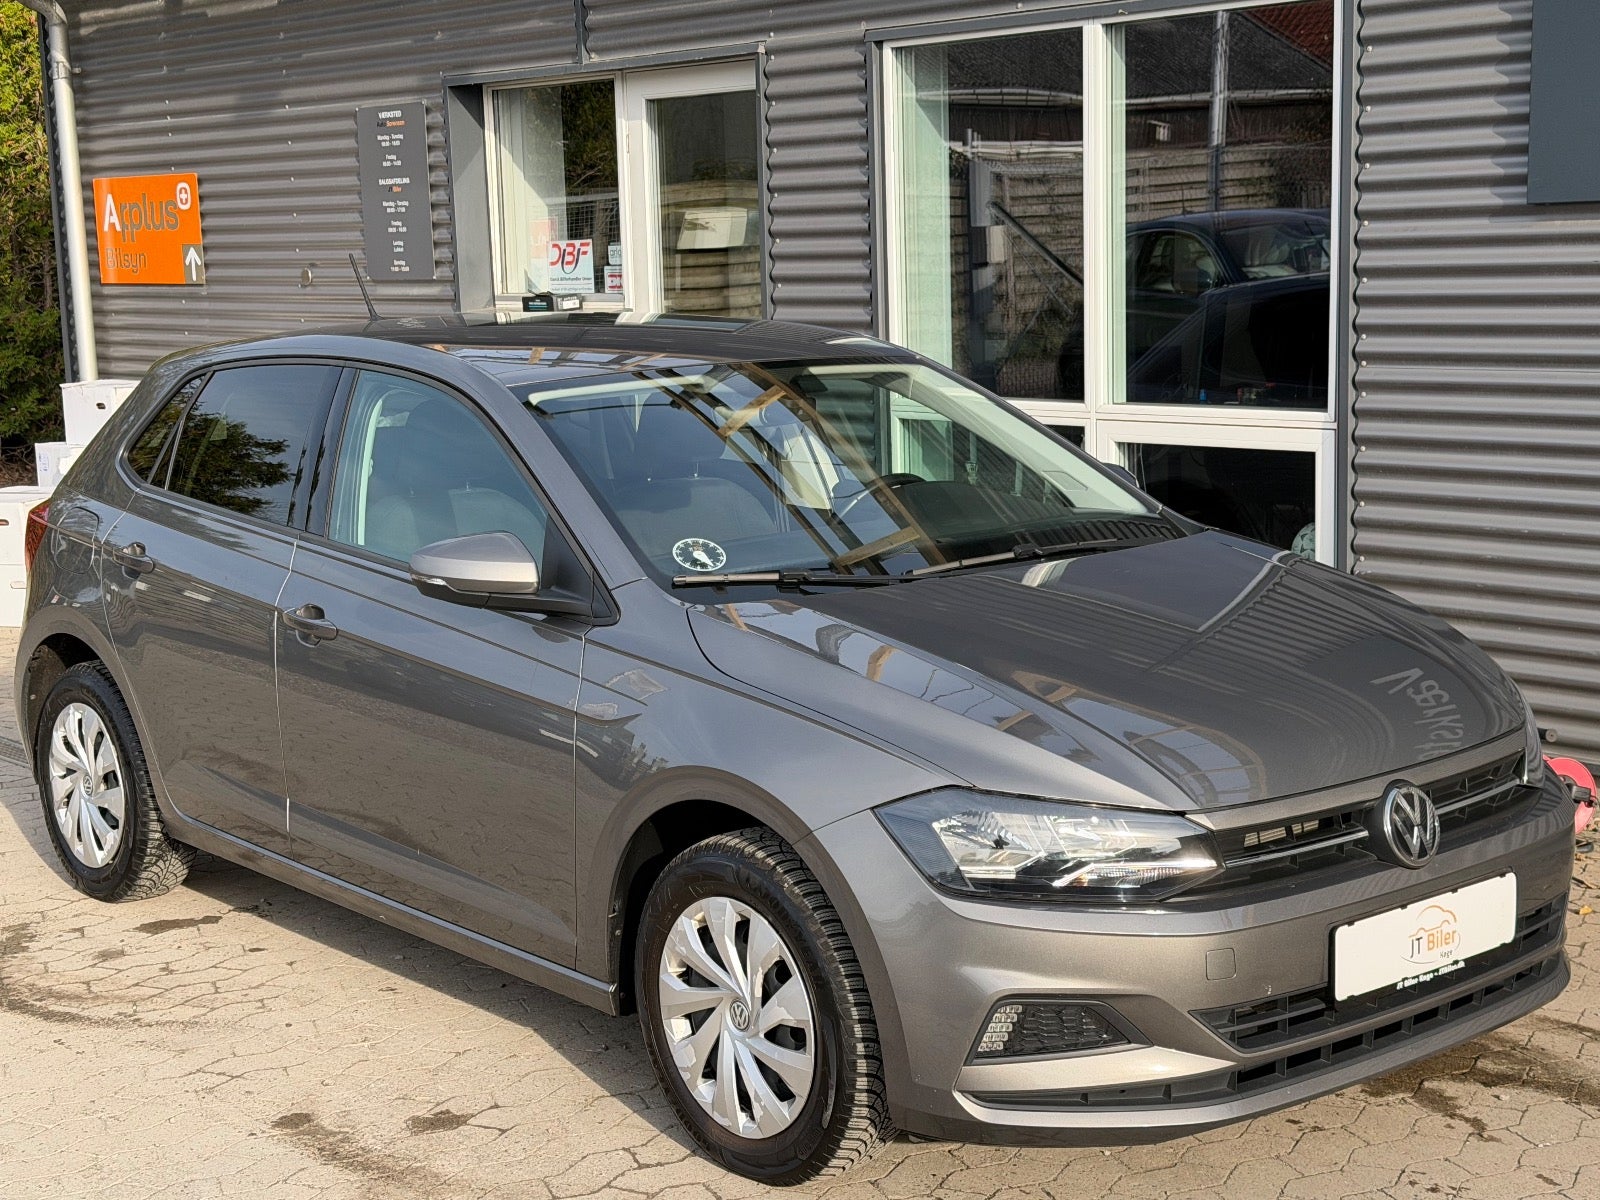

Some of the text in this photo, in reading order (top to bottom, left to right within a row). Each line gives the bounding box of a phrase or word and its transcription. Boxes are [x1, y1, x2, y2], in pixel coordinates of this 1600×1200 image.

[106, 247, 147, 274] Bilsyn
[1410, 929, 1457, 959] JT Biler
